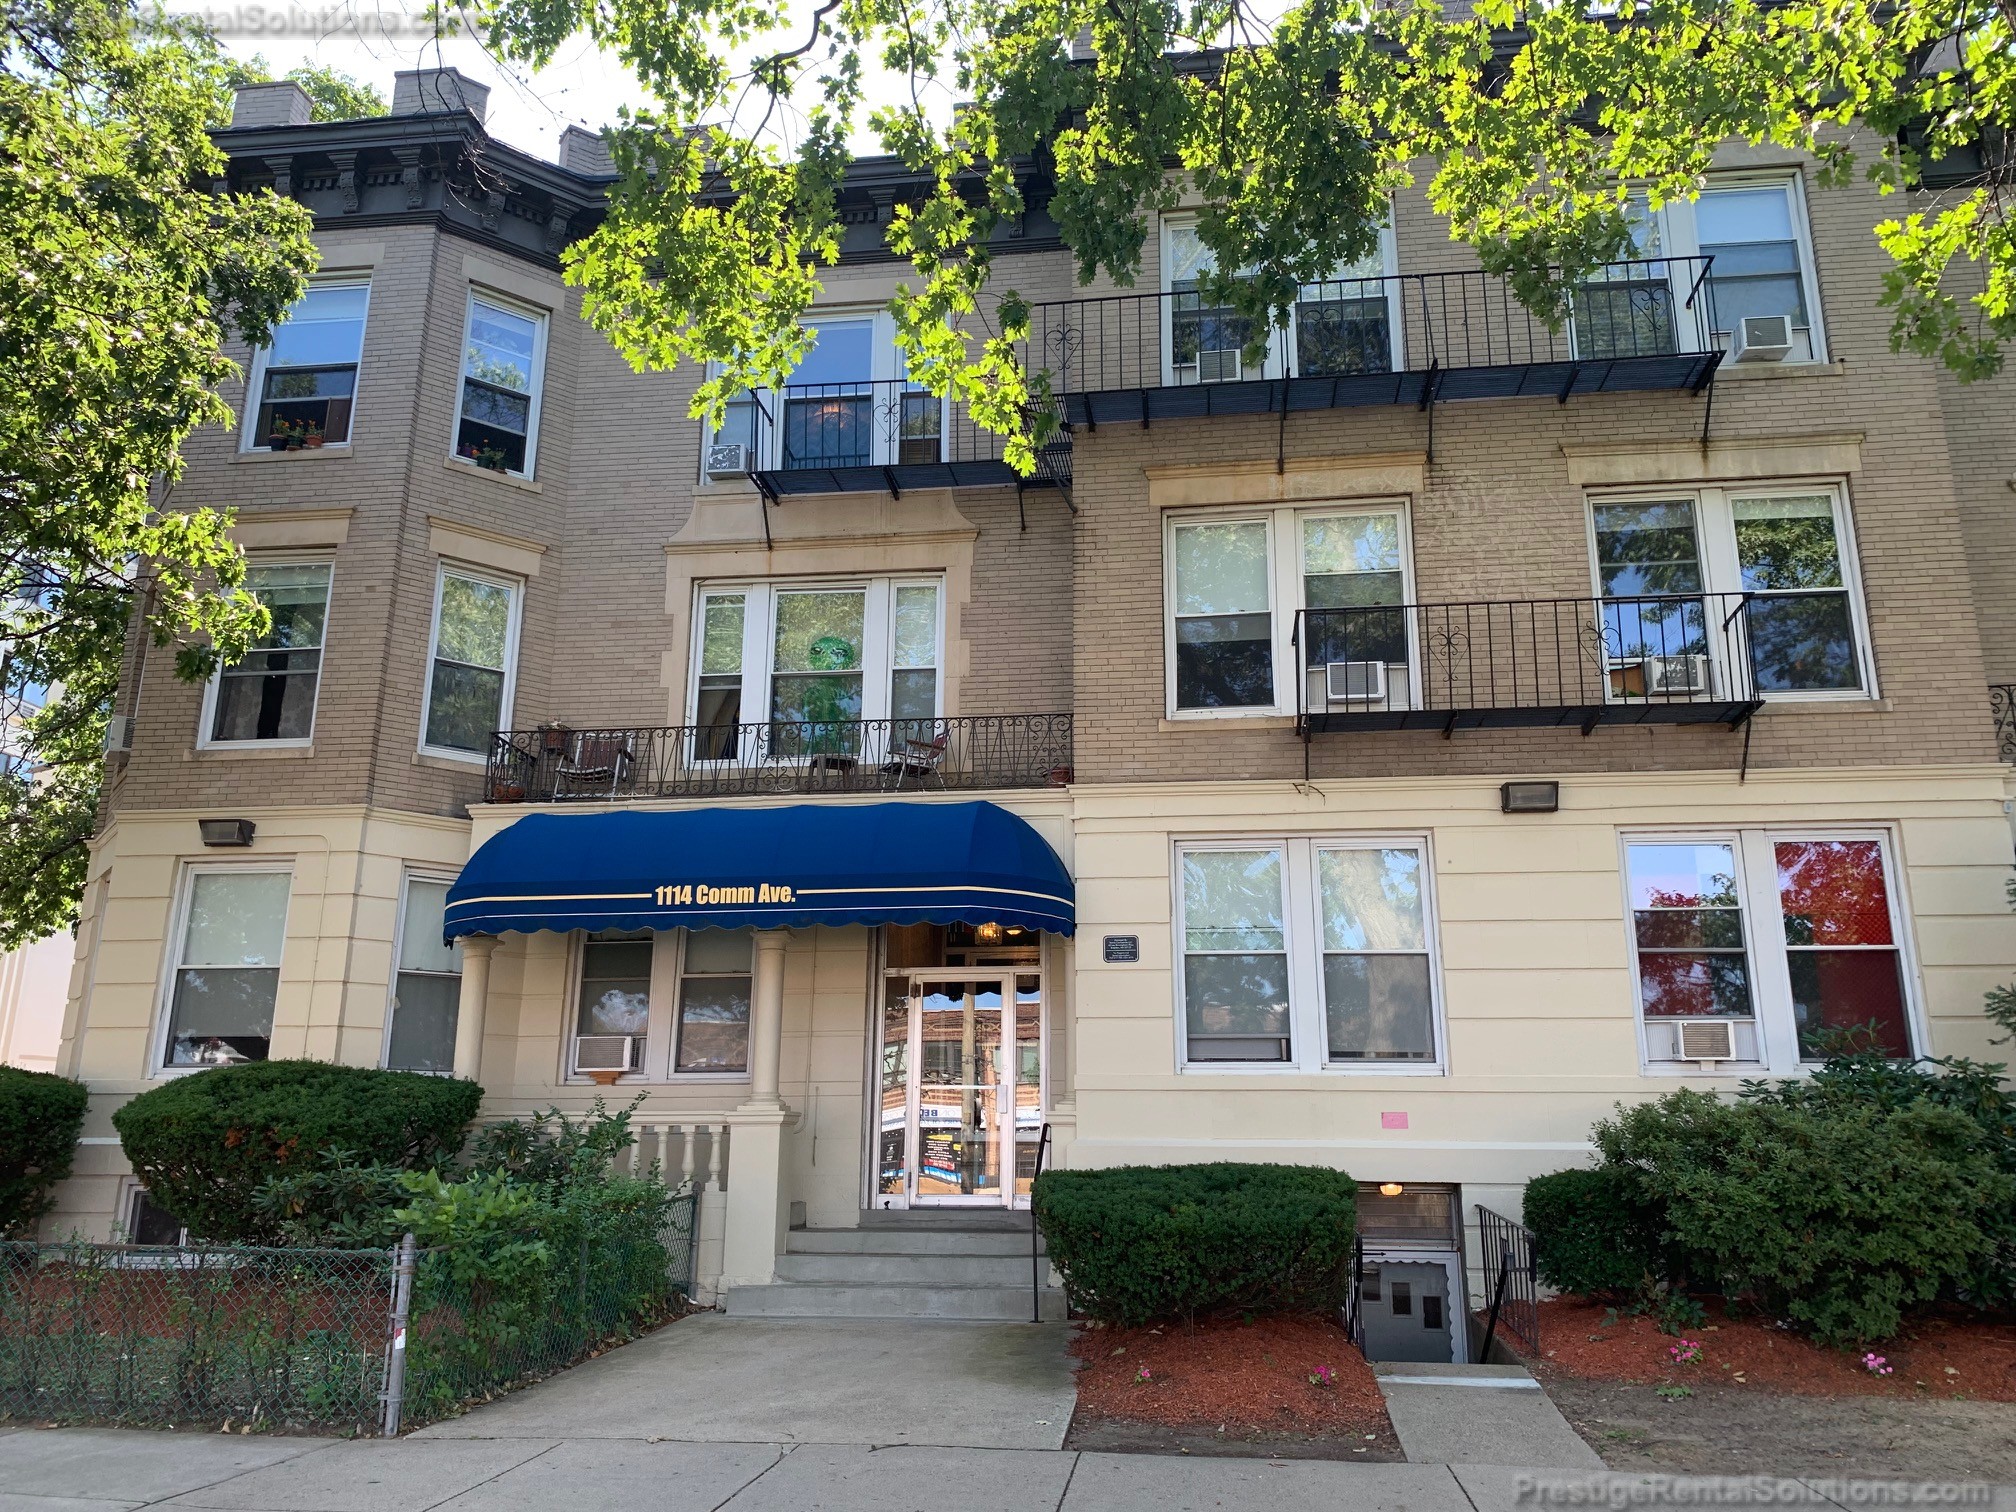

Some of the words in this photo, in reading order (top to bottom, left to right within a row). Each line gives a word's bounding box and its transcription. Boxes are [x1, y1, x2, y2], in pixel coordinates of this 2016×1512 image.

[655, 885, 692, 905] 1114
[696, 884, 755, 904] Comm
[758, 883, 796, 903] Ave.
